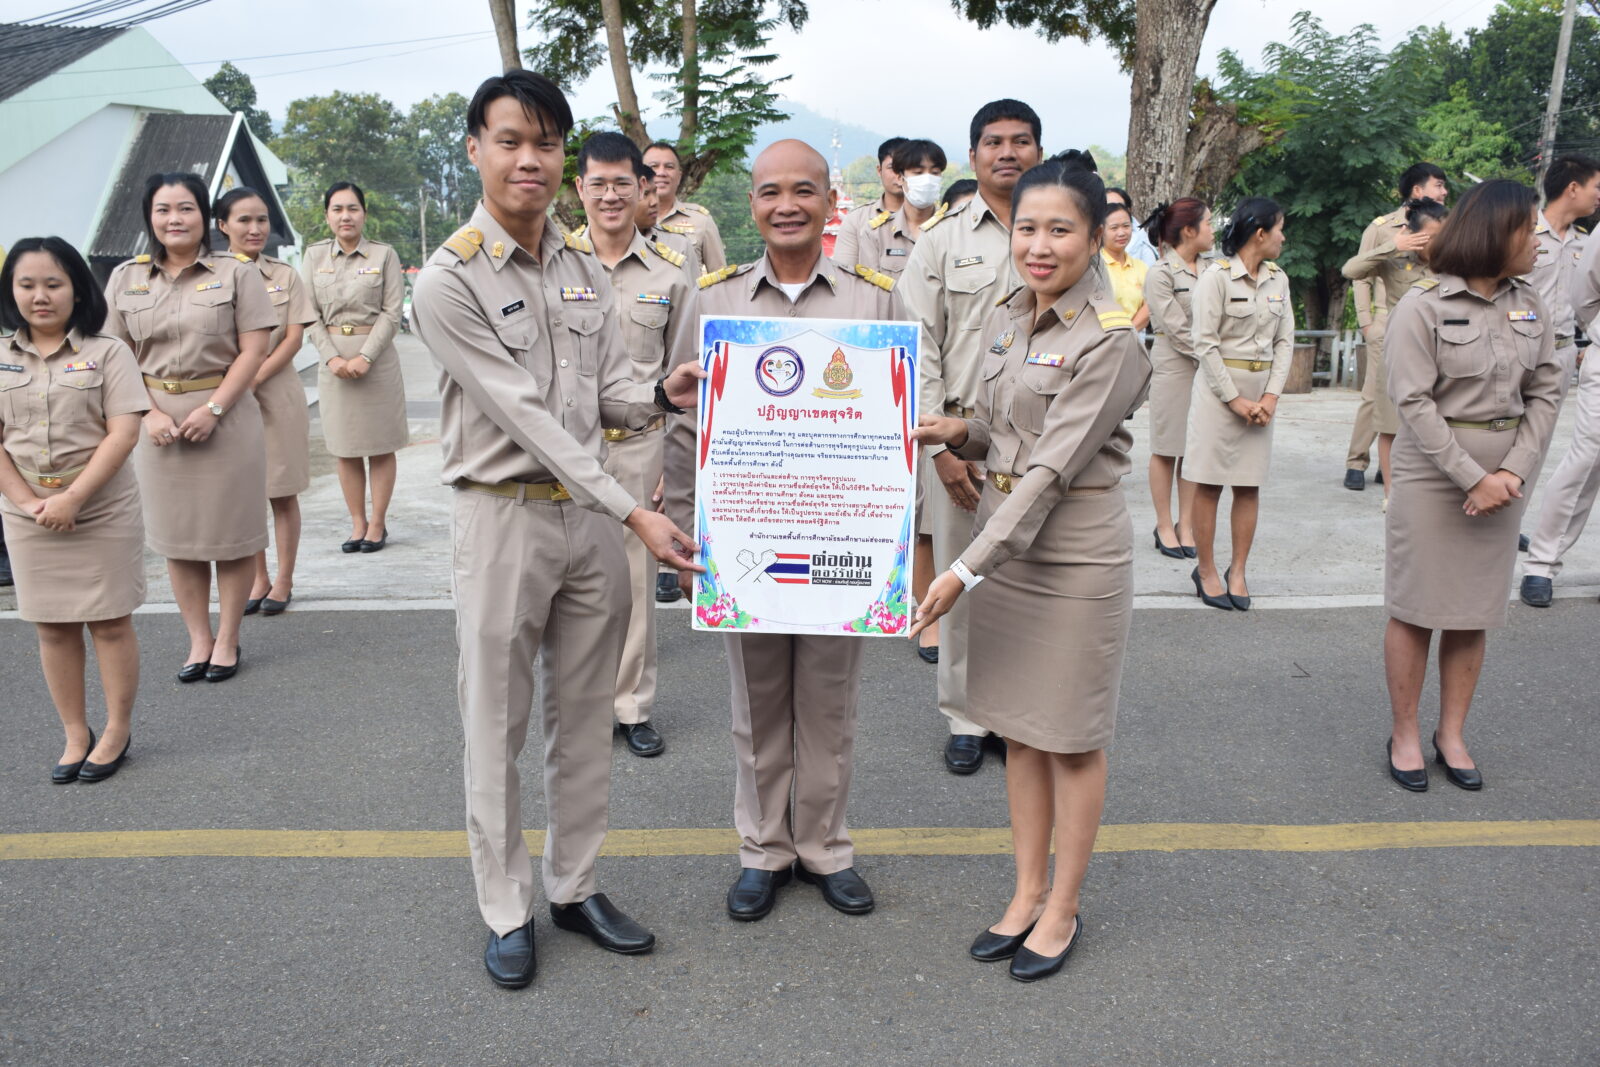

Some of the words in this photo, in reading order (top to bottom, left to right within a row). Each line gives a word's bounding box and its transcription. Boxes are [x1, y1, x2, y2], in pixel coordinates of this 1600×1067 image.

[757, 404, 862, 424] ปฏิญญาเขตสุจริต
[812, 551, 872, 568] ต่อต้าน
